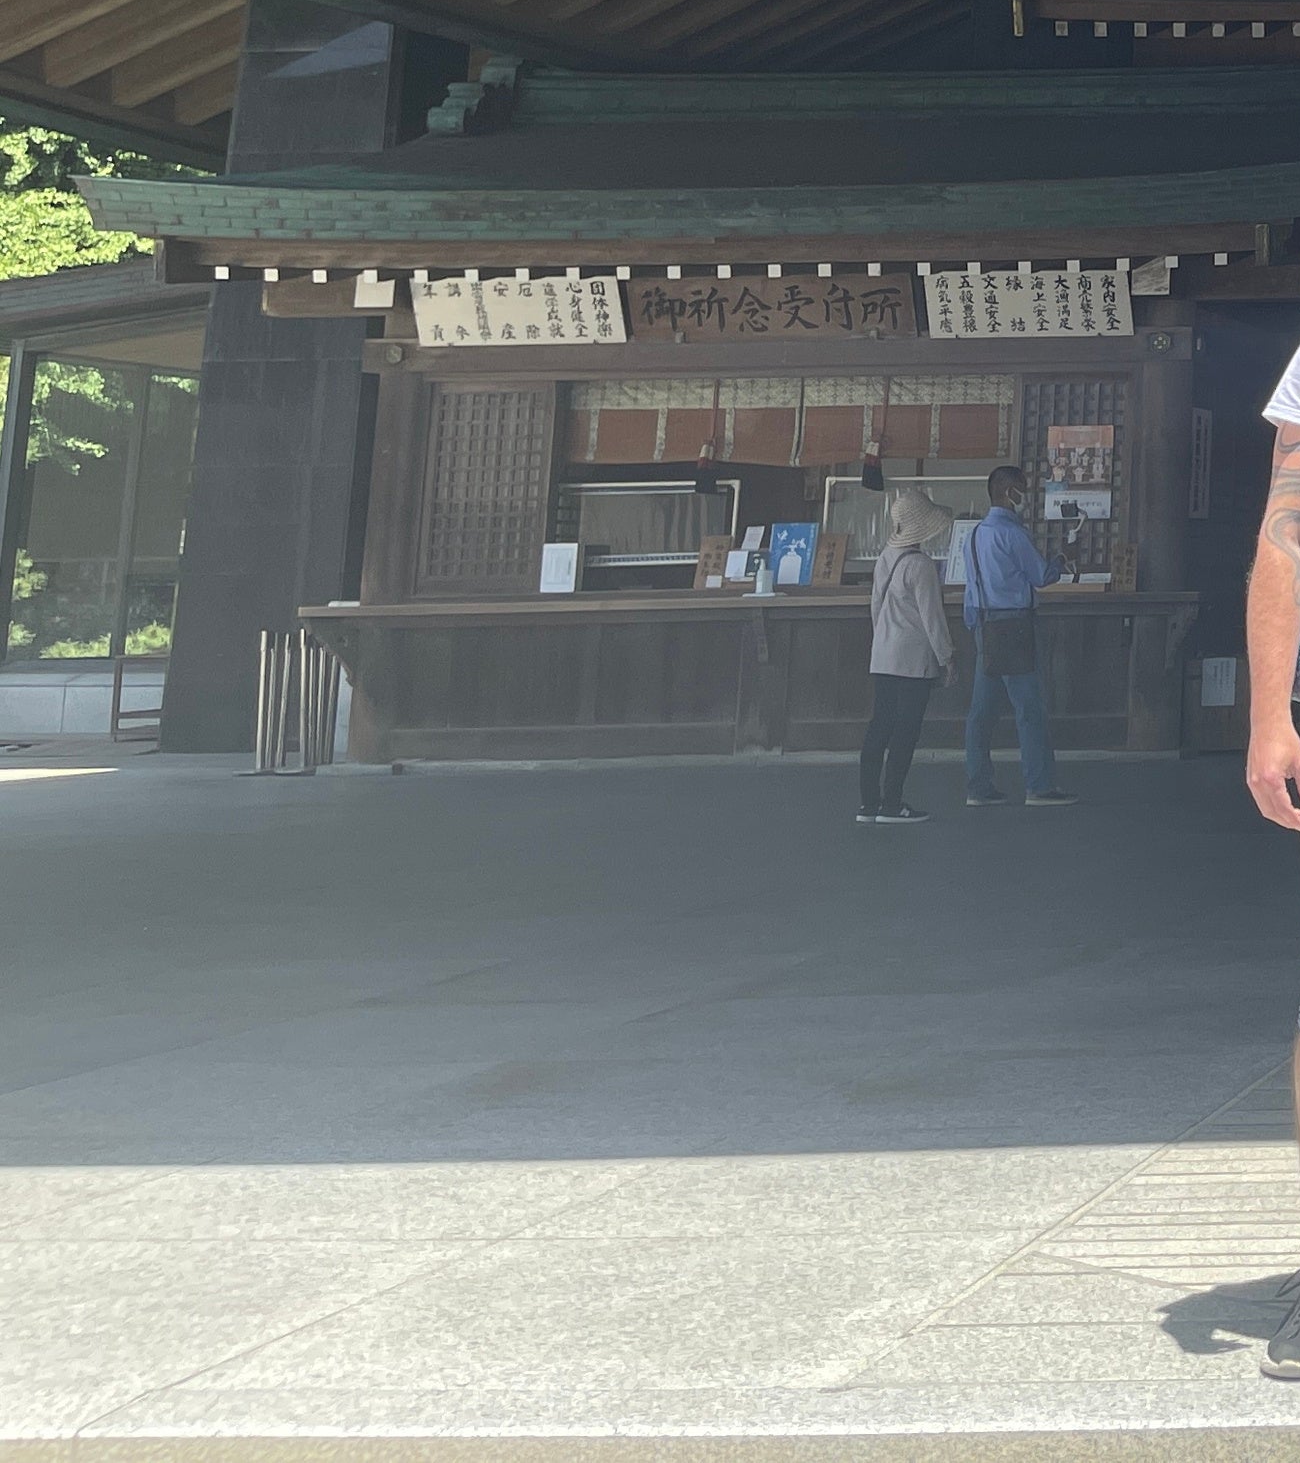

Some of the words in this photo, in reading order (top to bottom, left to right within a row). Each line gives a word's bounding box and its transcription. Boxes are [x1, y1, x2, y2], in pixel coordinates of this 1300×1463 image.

[640, 283, 902, 333] 御祈念受付所
[1029, 275, 1050, 332] 海上安全
[1100, 274, 1121, 332] 家内安全
